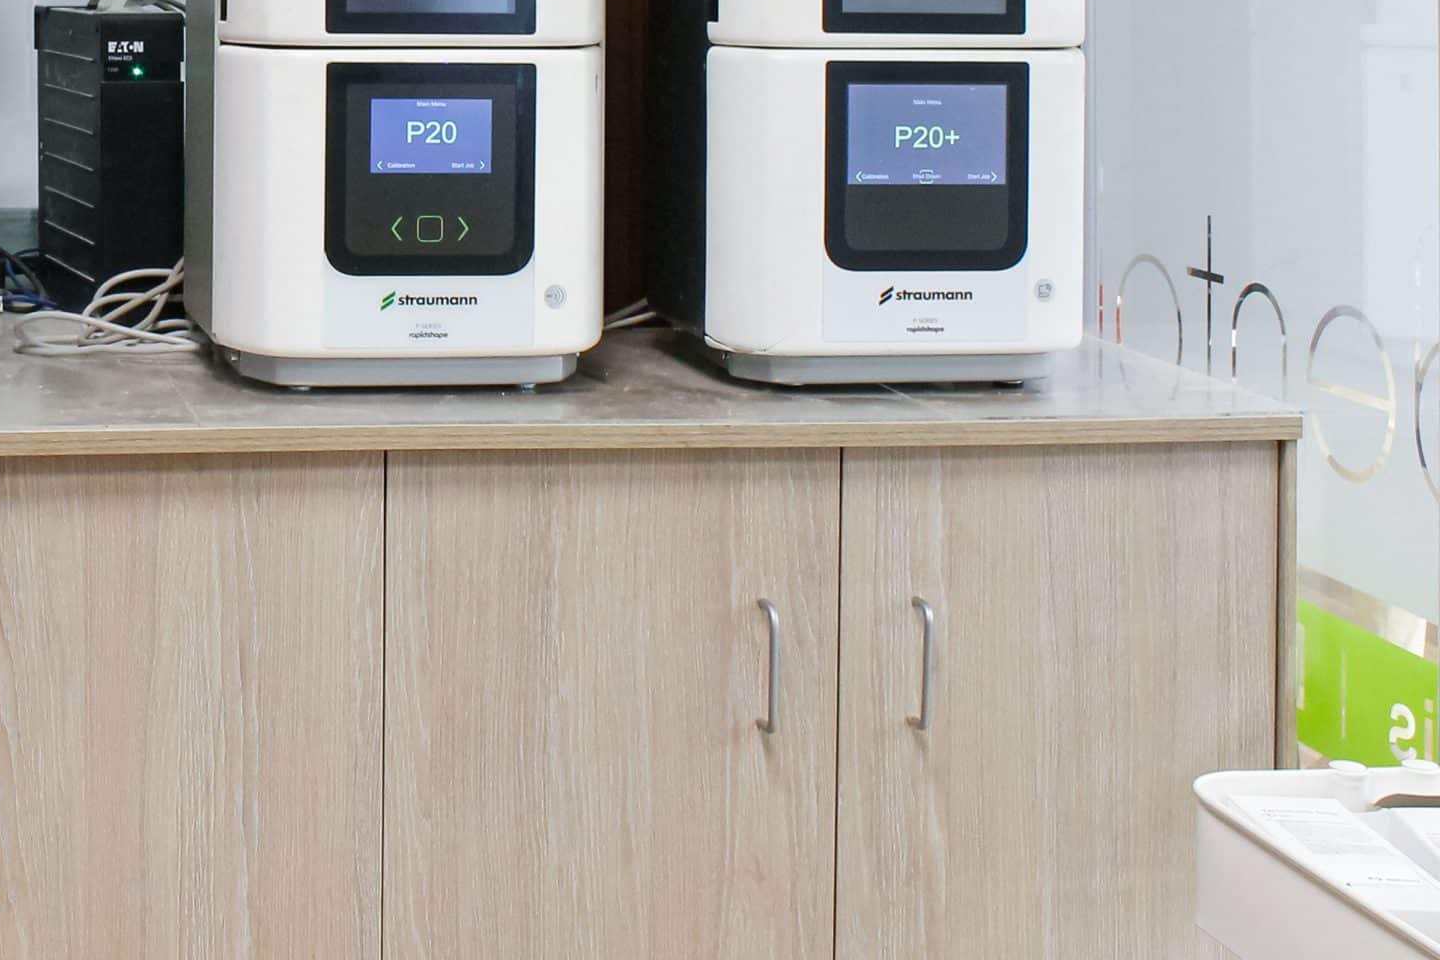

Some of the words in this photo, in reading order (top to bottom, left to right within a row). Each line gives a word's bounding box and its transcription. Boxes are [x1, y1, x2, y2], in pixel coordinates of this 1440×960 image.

[108, 41, 144, 53] EATON
[407, 121, 458, 144] P20
[895, 125, 960, 149] P20+
[398, 294, 478, 306] straumann
[895, 289, 974, 301] straumann
